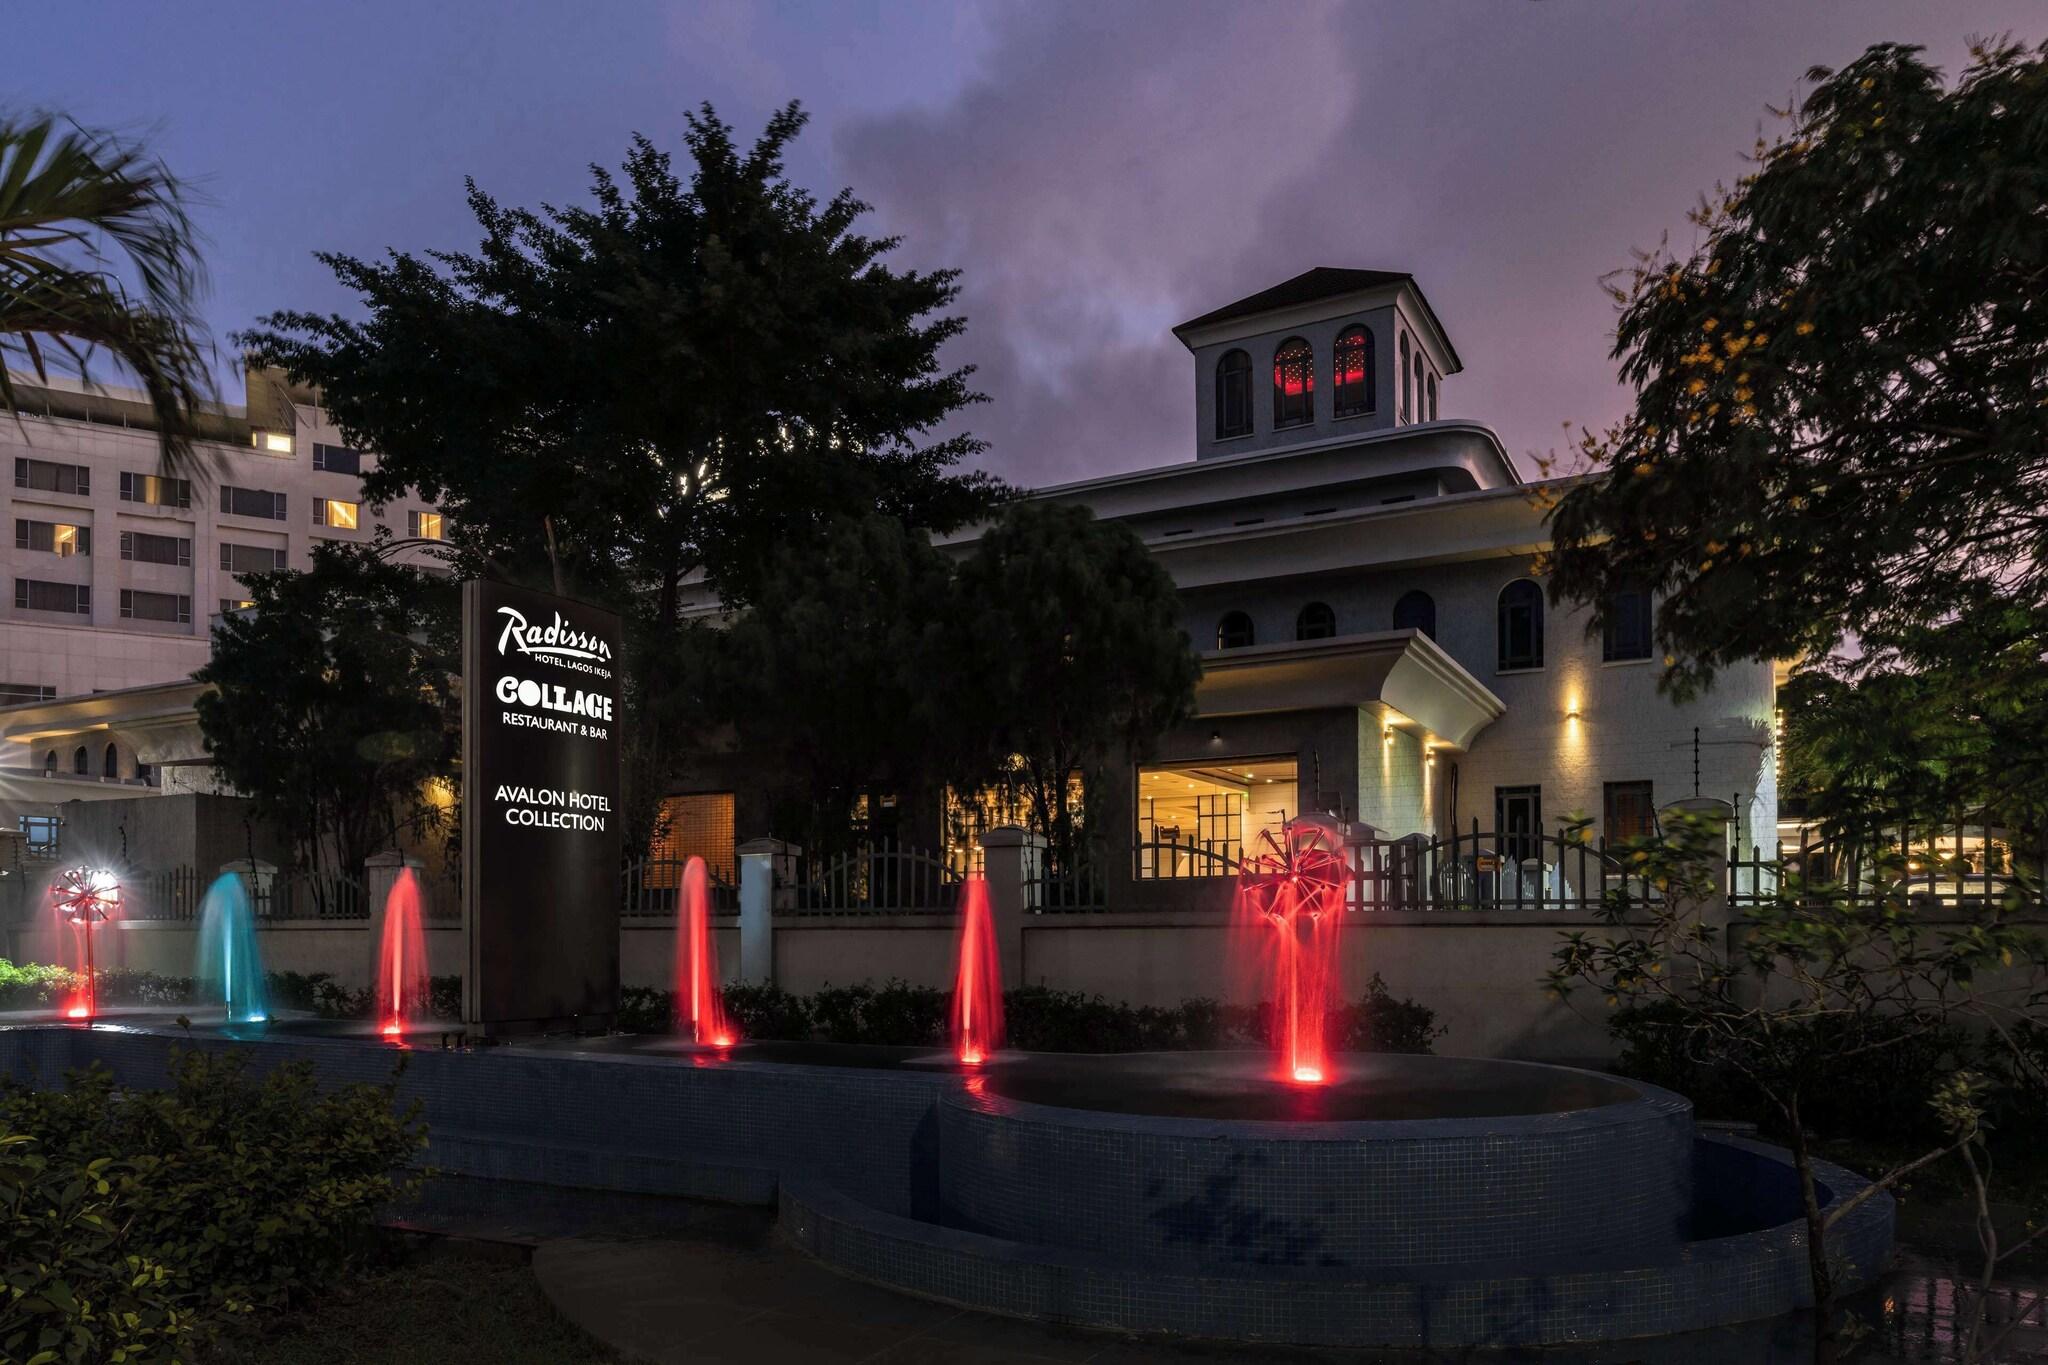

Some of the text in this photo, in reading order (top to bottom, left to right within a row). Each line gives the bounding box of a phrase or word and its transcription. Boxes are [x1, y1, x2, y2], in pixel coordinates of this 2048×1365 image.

[497, 606, 611, 662] Radisson
[567, 660, 593, 674] LAGOS
[594, 666, 612, 679] IKEJA
[496, 676, 612, 721] COLLAGE
[503, 712, 608, 740] RESTAURANT & BAR
[495, 785, 611, 812] AVALON HOTEL
[505, 808, 604, 831] COLLECTION
